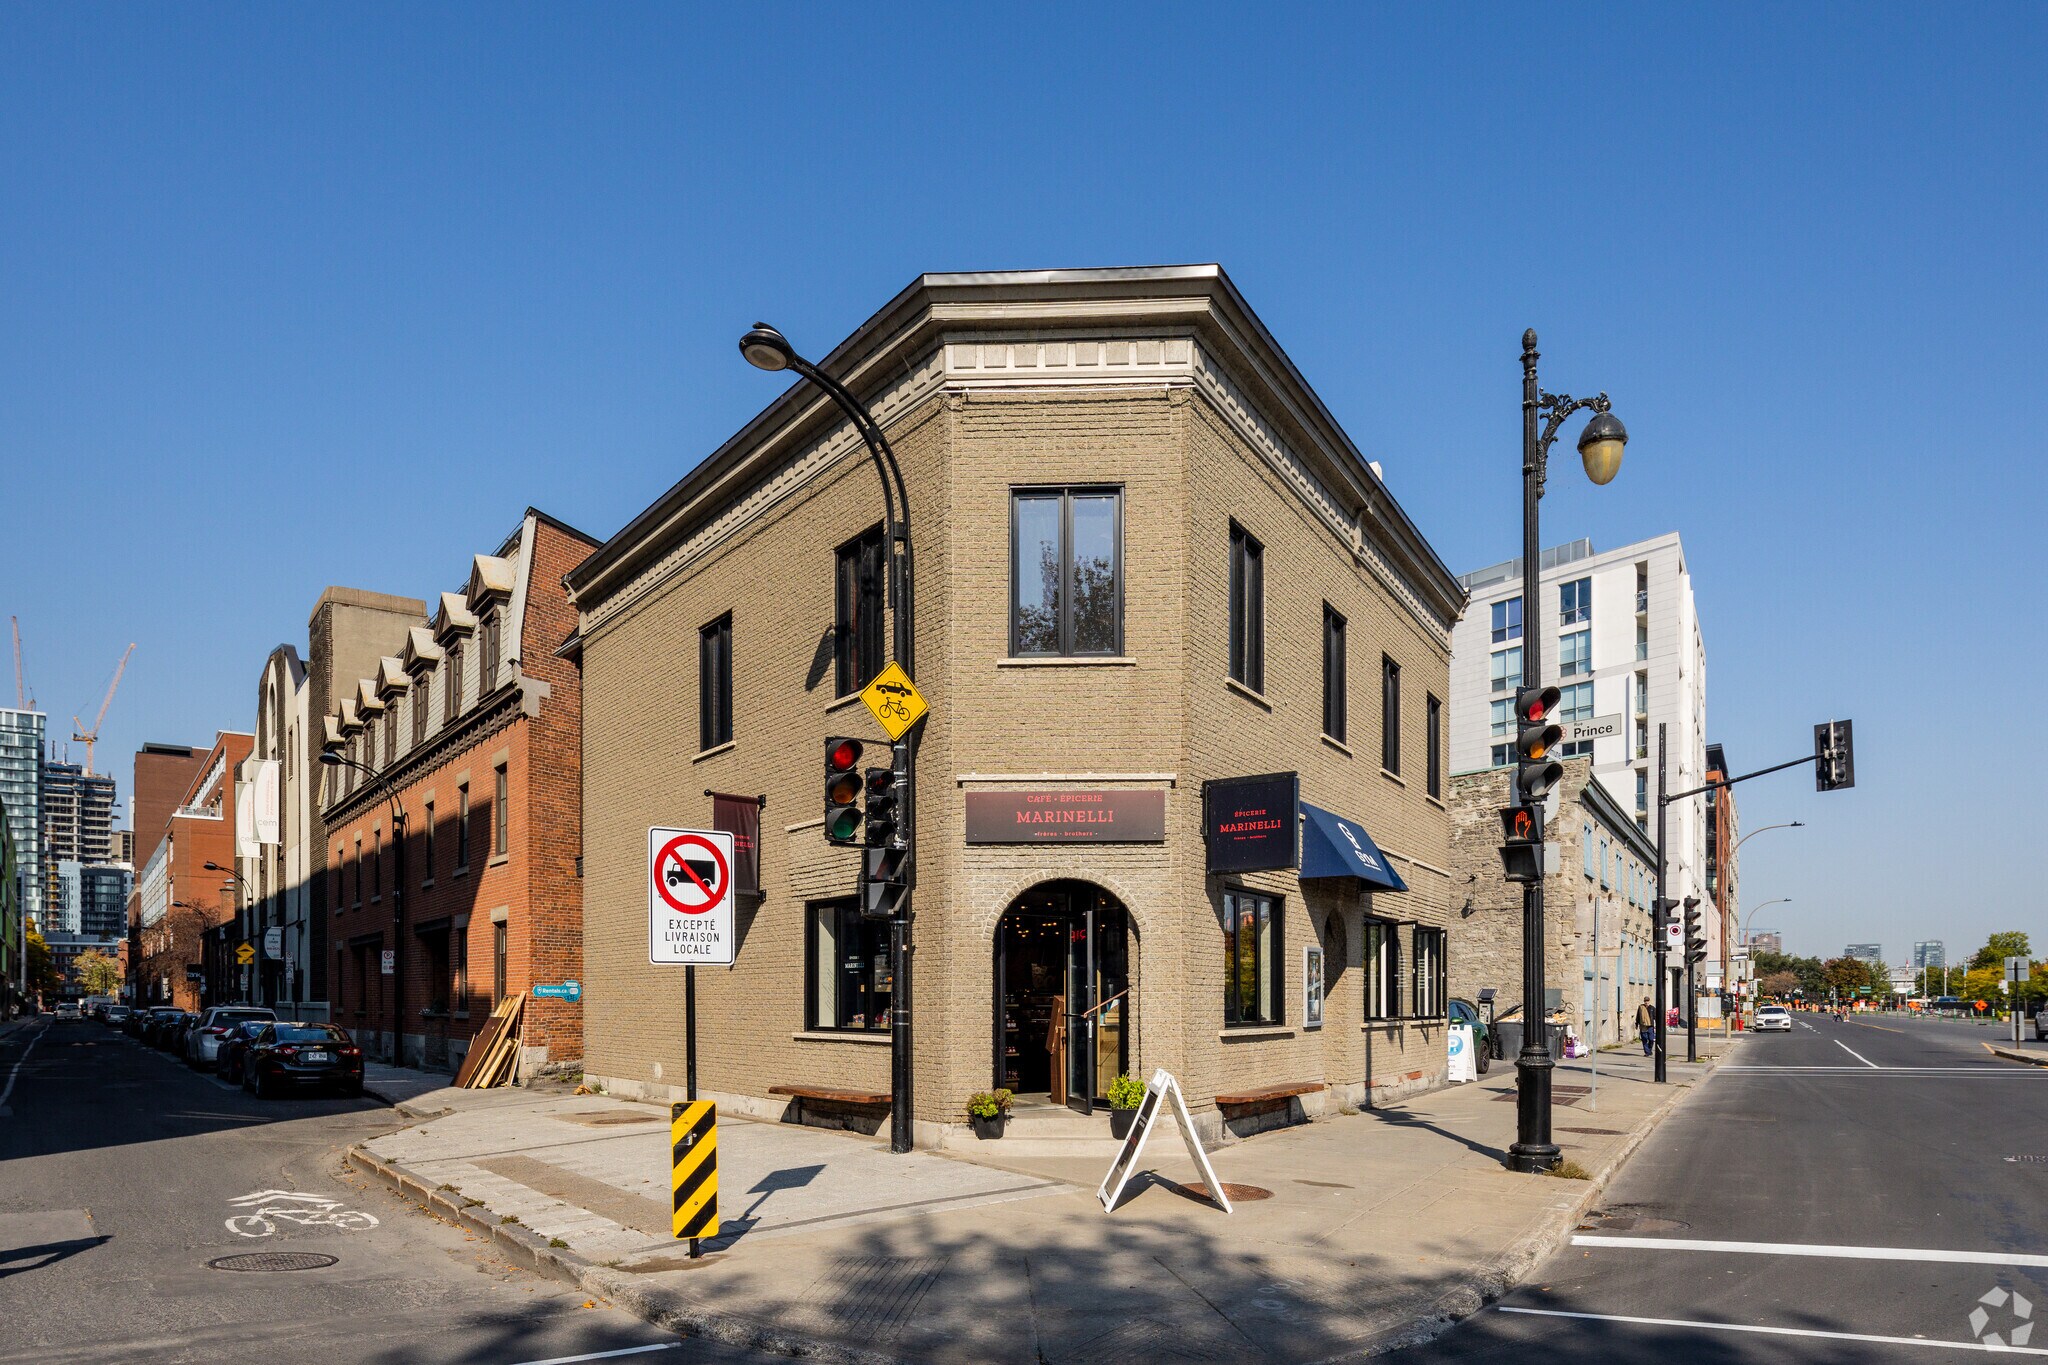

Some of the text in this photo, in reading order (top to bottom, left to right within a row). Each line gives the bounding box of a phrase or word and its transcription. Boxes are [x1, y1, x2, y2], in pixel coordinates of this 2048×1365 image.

[1573, 724, 1613, 738] Prince
[1027, 793, 1103, 803] CAFÉ ÉPICERIE
[1016, 810, 1114, 824] MARINELLI
[1234, 809, 1267, 818] ÉPICERIE
[1220, 819, 1281, 833] MARINELLI
[1355, 850, 1379, 867] GYM
[669, 919, 716, 930] EXCEPTÉ
[665, 932, 720, 943] LIVRAISON
[674, 944, 711, 955] LOCALE
